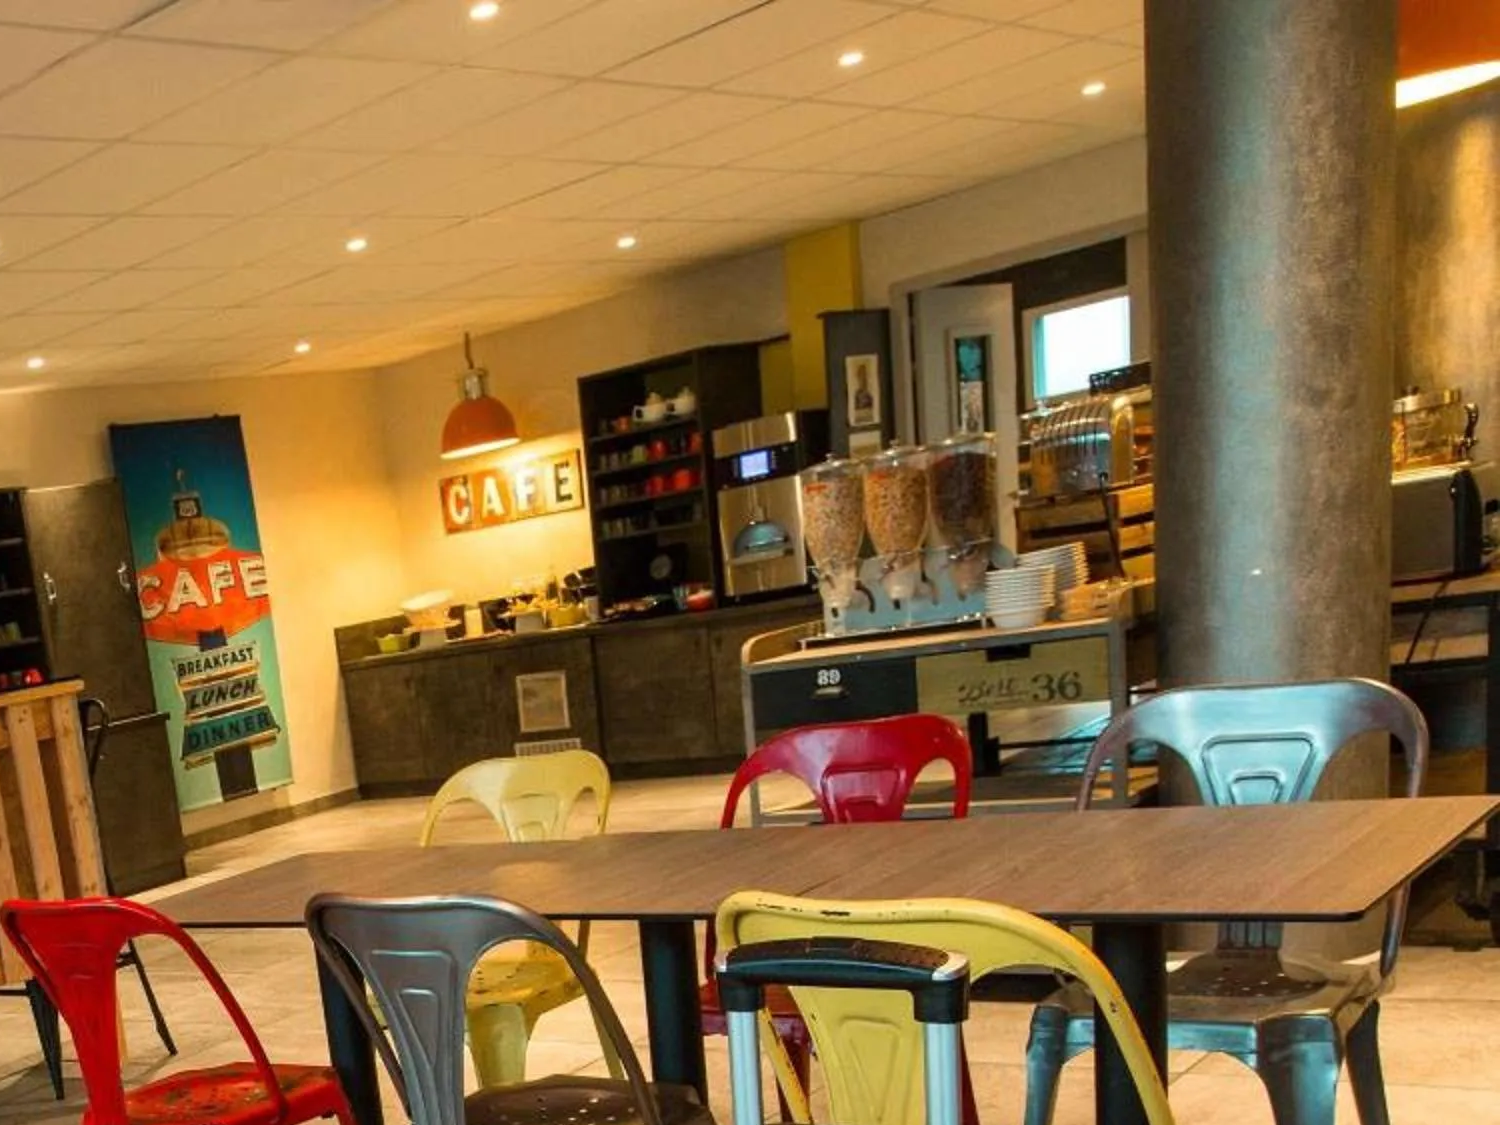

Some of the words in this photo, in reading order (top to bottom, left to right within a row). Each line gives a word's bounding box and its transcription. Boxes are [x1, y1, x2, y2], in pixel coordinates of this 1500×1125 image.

[449, 460, 574, 525] CAFE
[137, 555, 269, 620] CAFE
[177, 646, 254, 677] BREAKFAST
[188, 679, 257, 710] LUNCH
[1030, 670, 1083, 701] 36
[187, 711, 272, 751] DINNER
